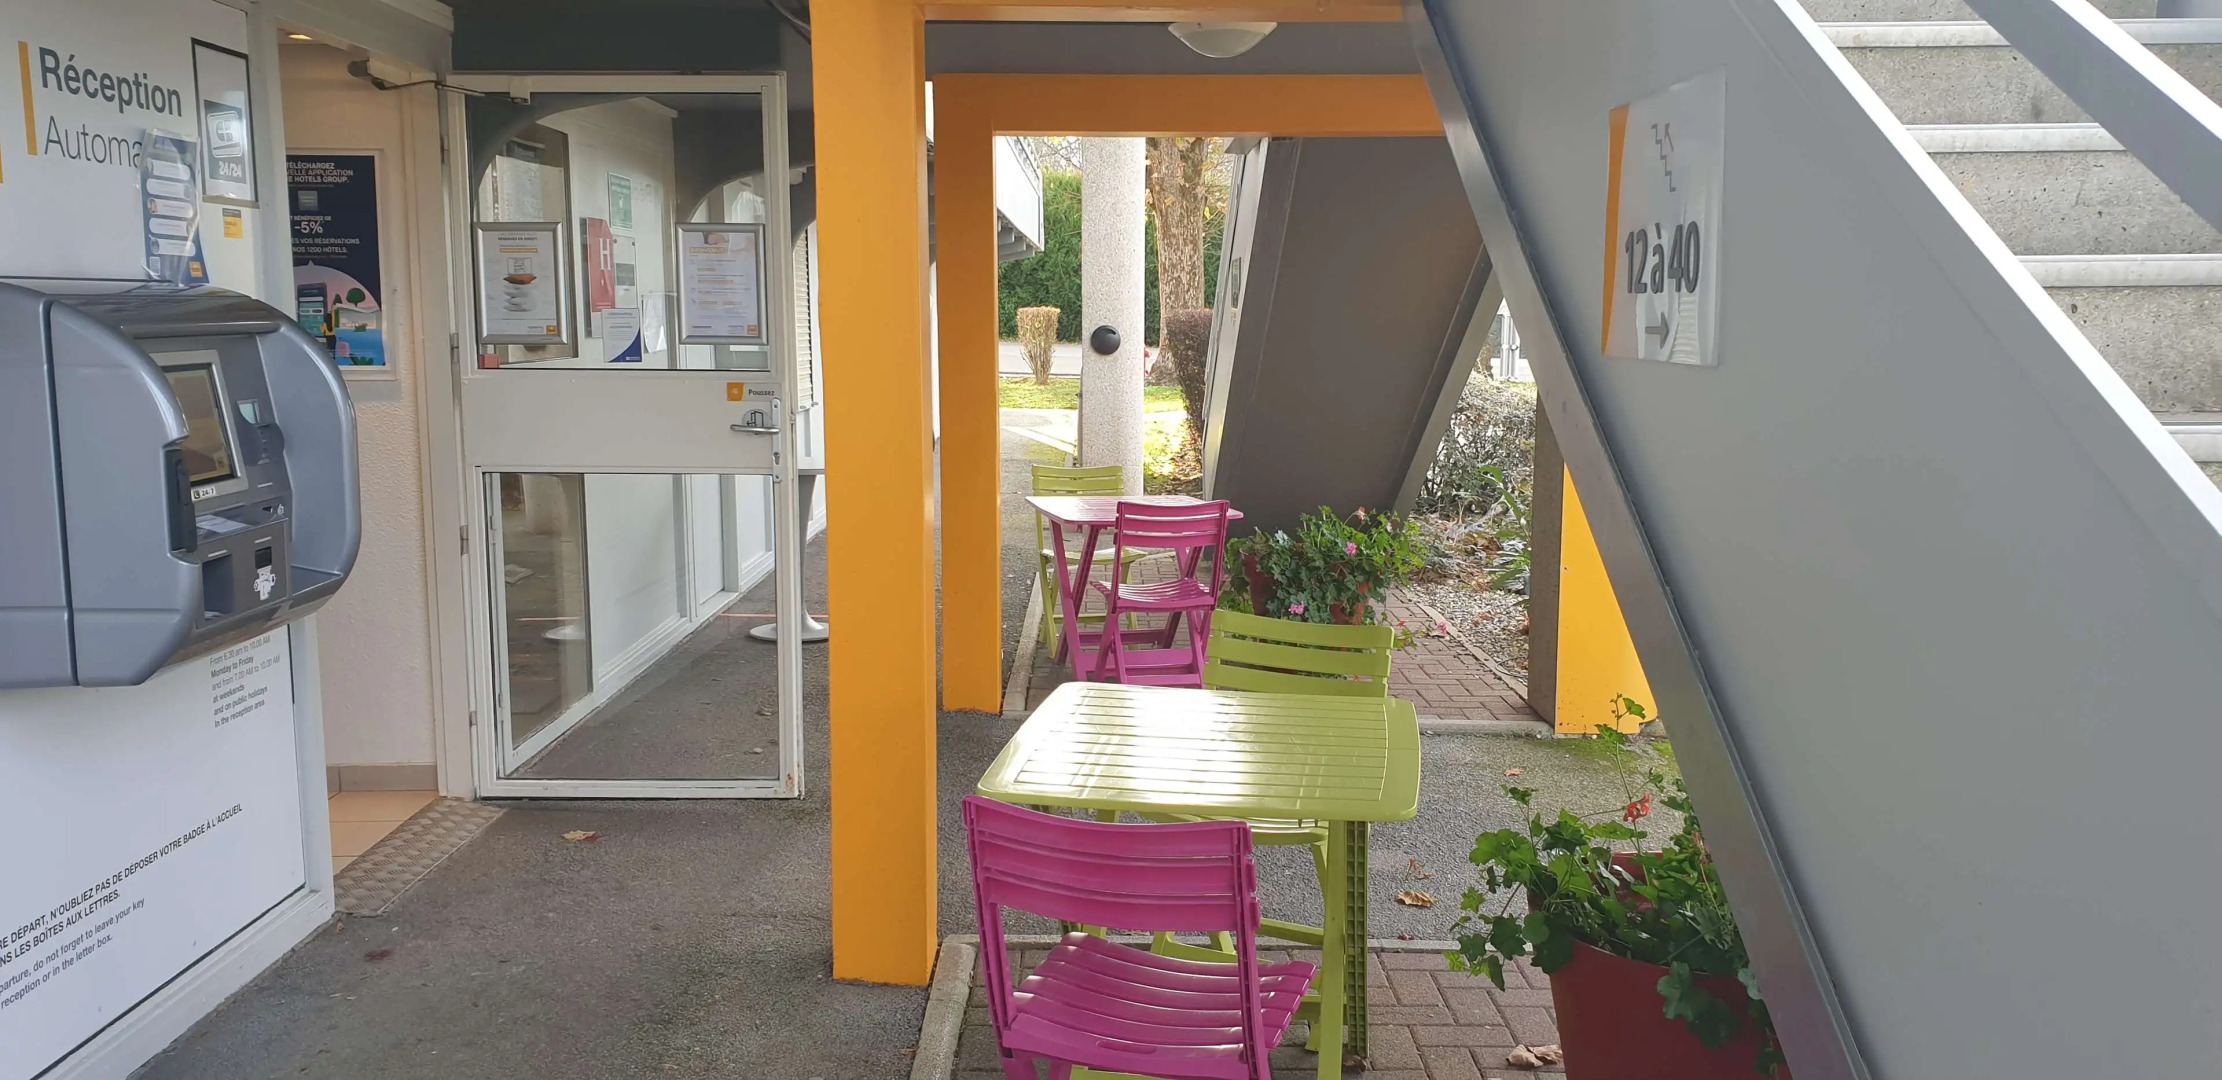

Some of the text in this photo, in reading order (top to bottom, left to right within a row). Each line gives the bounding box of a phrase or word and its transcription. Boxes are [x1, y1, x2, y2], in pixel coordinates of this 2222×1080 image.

[39, 46, 182, 118] Réception
[218, 161, 242, 178] 24/24
[295, 175, 322, 183] HOTELS
[209, 655, 223, 665] From
[223, 649, 234, 661] 6.30
[211, 656, 254, 678] Monday to Friday
[212, 681, 221, 691] and
[222, 676, 234, 686] from
[254, 665, 259, 673] to
[212, 684, 245, 704] at weekends
[213, 686, 268, 716] and on public holidays
[220, 716, 229, 725] the
[230, 705, 254, 721] reception
[254, 699, 265, 710] area
[10, 914, 49, 944] DÉPART,
[50, 888, 94, 921] N'OUBLIEZ
[95, 878, 111, 895] PAS
[112, 871, 123, 885] DE
[124, 851, 159, 878] DÉPOSER
[159, 837, 182, 858] VOTRE
[183, 824, 206, 844] BADGE
[206, 818, 211, 831] À
[212, 803, 243, 828] L'ACCUEIL
[14, 940, 31, 959] LES
[33, 920, 64, 948] BOÎTES
[66, 909, 83, 928] AUX
[84, 889, 121, 917] LETTRES.
[33, 959, 44, 972] do
[46, 948, 59, 965] not
[60, 934, 84, 955] forget
[85, 928, 93, 941] to
[94, 917, 114, 935] leave
[115, 906, 131, 924] your
[132, 898, 145, 912] key
[1, 933, 113, 1009] reception or in the letter box.
